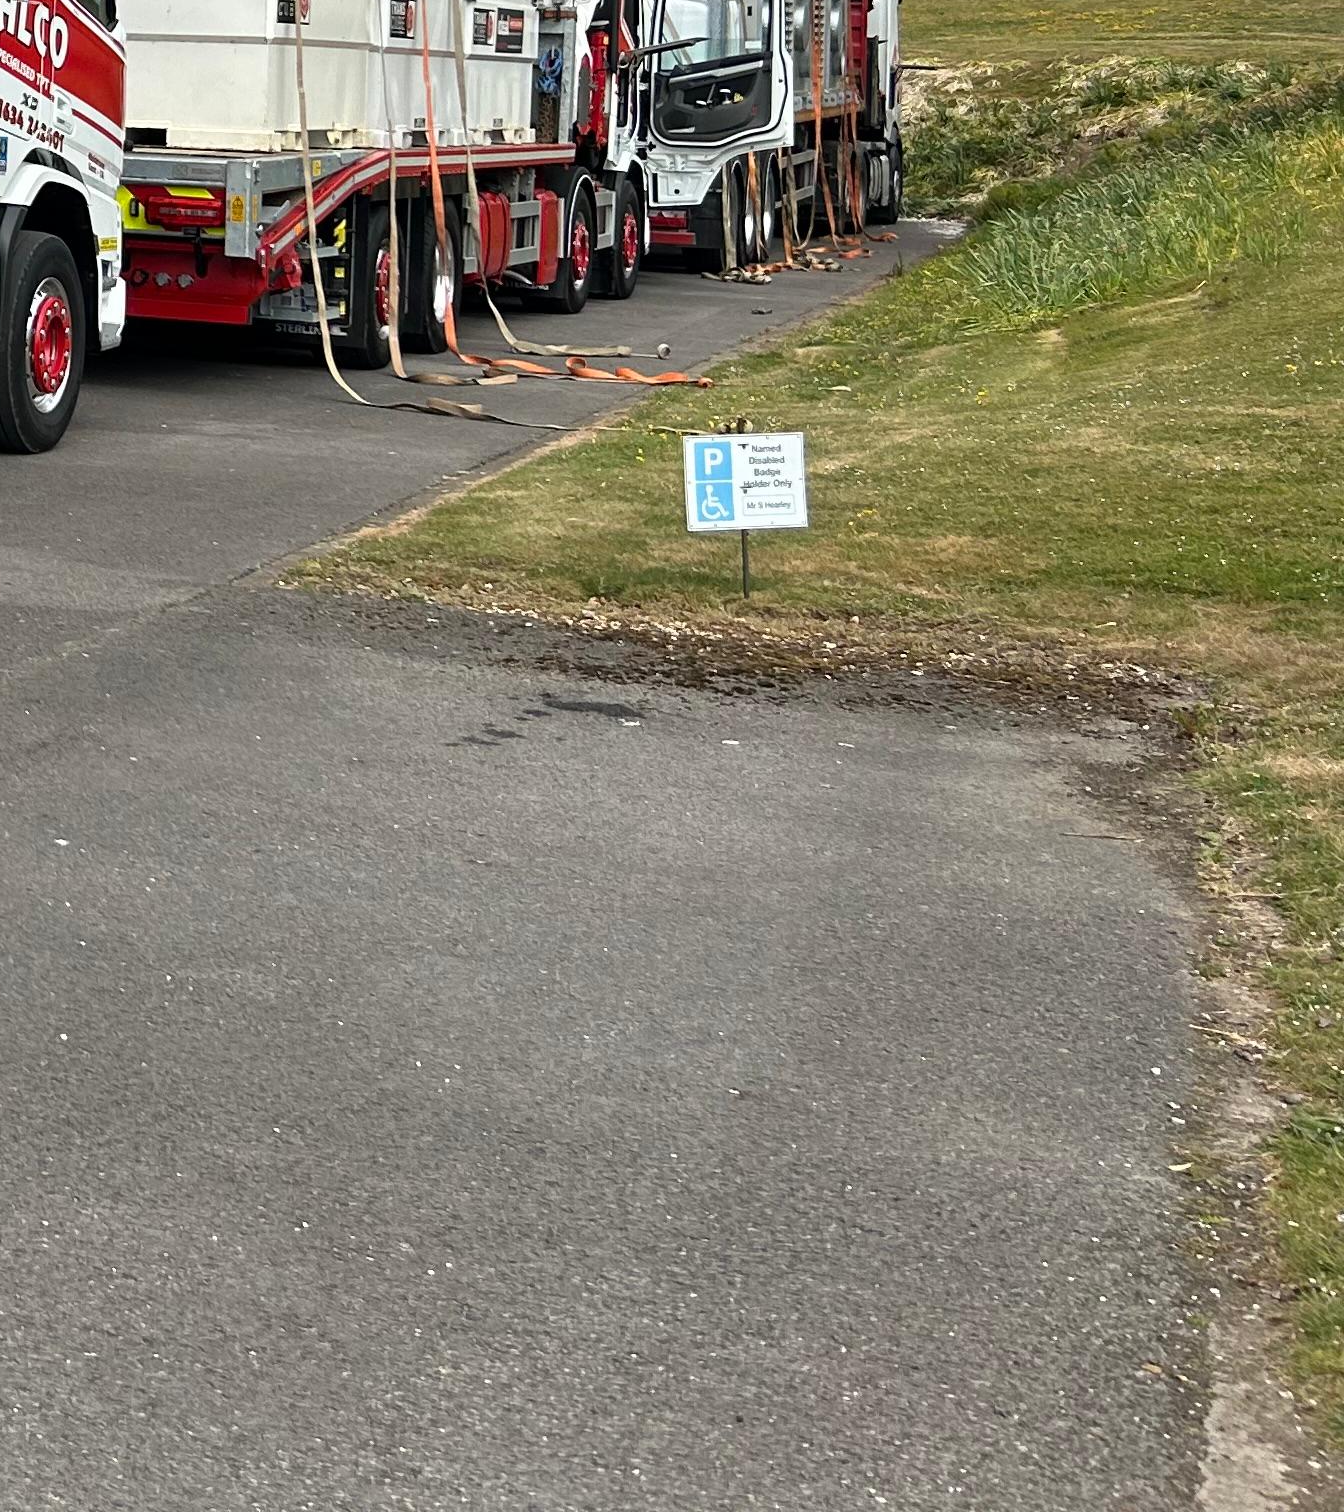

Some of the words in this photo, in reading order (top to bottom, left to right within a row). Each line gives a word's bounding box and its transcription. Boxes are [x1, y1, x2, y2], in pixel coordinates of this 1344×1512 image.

[275, 322, 322, 336] STERLIN
[703, 447, 724, 475] P
[748, 456, 785, 464] Disabled
[754, 468, 781, 477] Badge
[744, 479, 770, 488] Holder
[773, 478, 792, 489] Only
